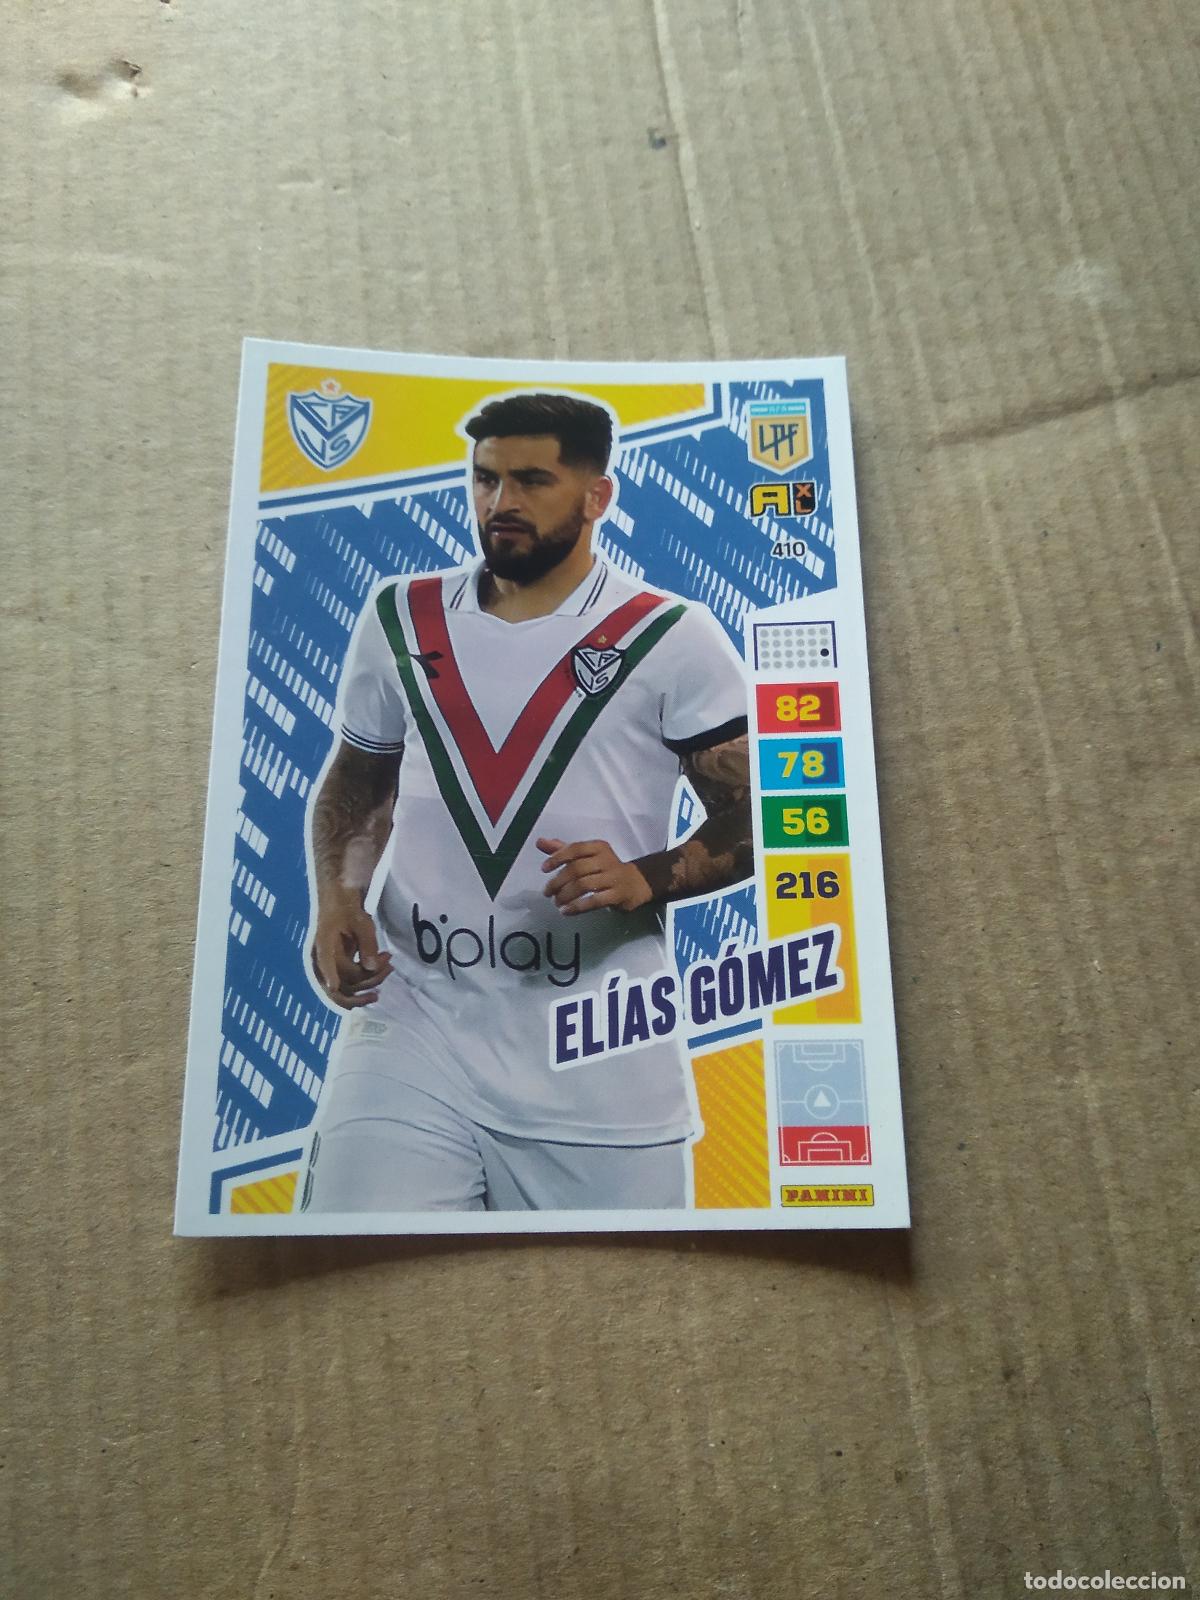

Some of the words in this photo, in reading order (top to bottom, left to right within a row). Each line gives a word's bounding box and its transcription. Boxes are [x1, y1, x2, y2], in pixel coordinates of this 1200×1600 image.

[772, 541, 805, 557] 410
[776, 695, 821, 721] 82
[777, 750, 825, 778] 78
[782, 807, 830, 835] 56
[776, 871, 840, 899] 216
[412, 902, 581, 987] bplay
[556, 975, 676, 1064] ELÍAS
[690, 929, 838, 1025] GÓMEZ
[785, 1189, 869, 1202] PANINI
